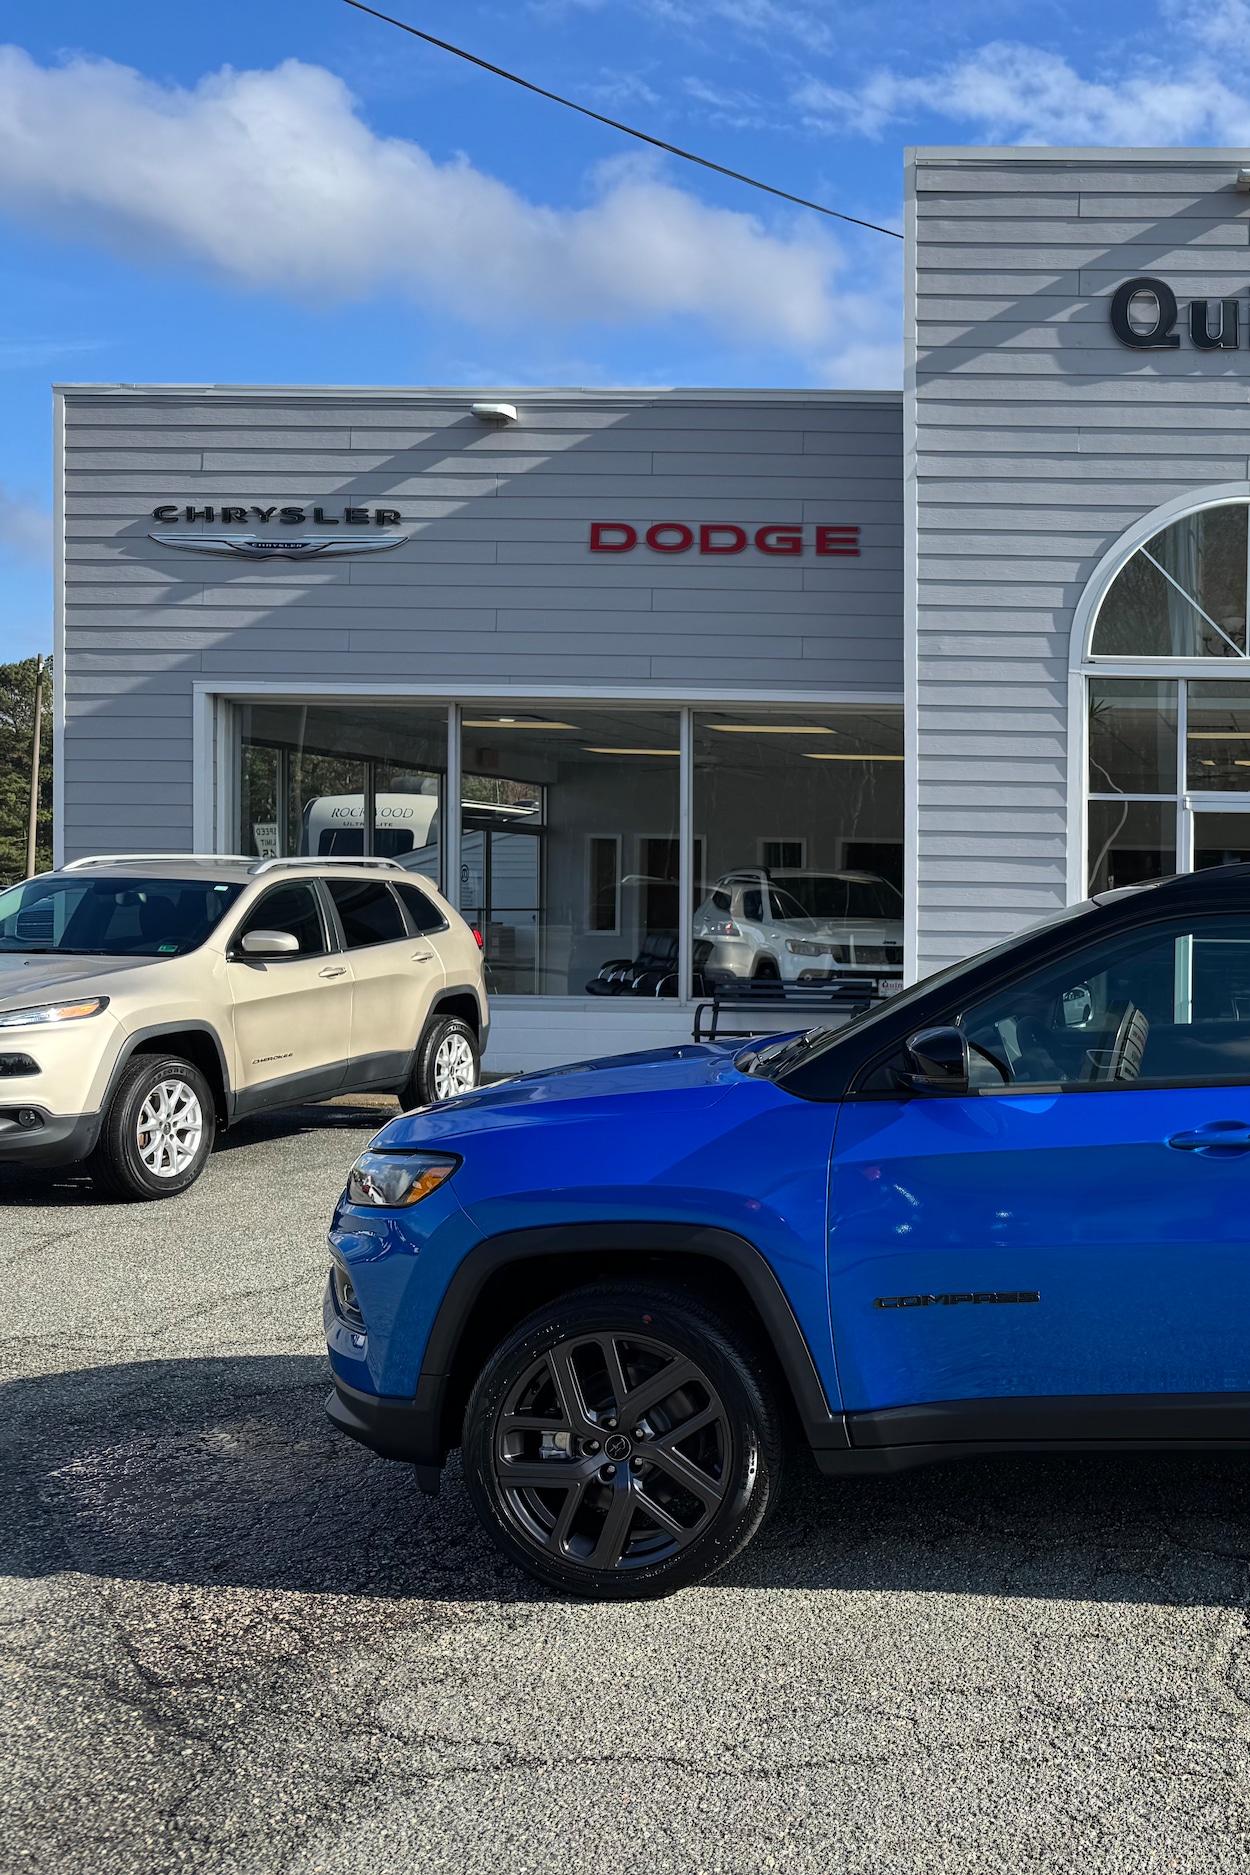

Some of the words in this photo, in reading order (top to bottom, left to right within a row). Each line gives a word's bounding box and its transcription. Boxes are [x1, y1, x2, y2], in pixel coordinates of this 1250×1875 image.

[152, 505, 402, 526] CHRYSLER
[590, 522, 861, 557] DODGE
[882, 979, 903, 988] Quin
[252, 1052, 294, 1064] CHEROKEE
[874, 1291, 1040, 1309] COMPASS
